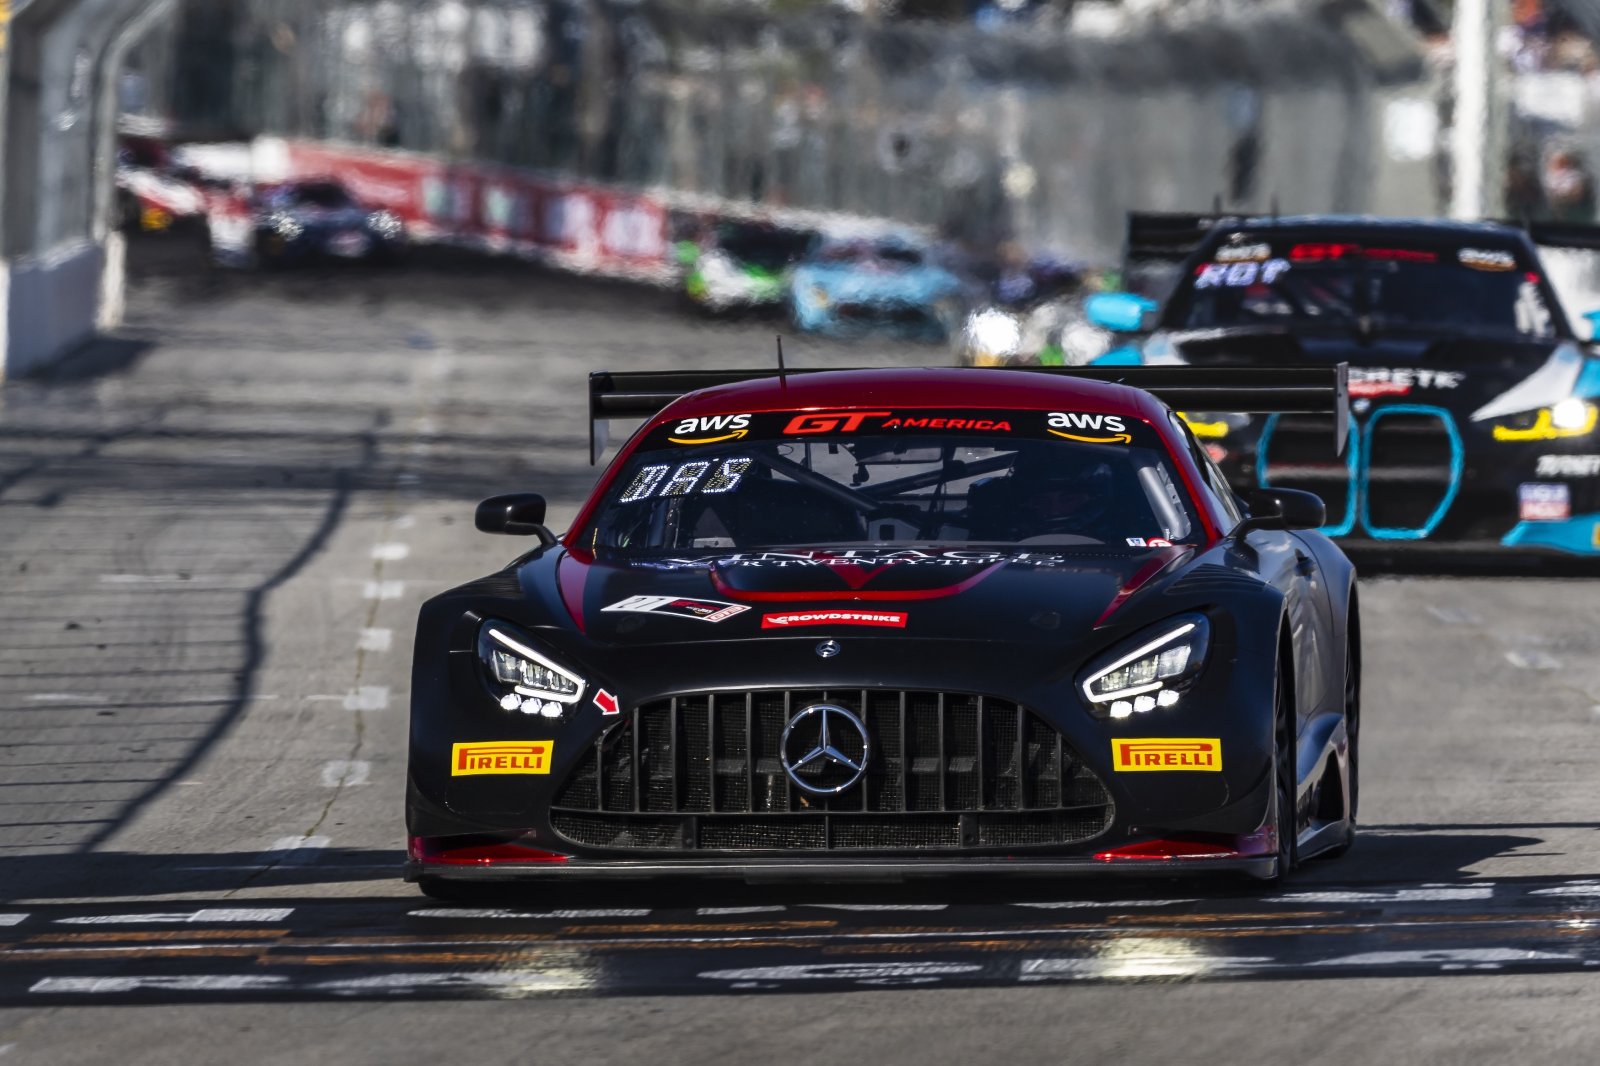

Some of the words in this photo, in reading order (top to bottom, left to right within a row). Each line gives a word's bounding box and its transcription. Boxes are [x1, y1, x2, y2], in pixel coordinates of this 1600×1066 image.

[674, 413, 752, 435] aws
[783, 411, 892, 435] GT
[881, 418, 1012, 431] AMERICA
[1047, 411, 1127, 432] aws
[767, 613, 901, 625] CROWDSTRIKE
[458, 746, 545, 771] PIRELLI
[1120, 743, 1213, 766] PIRELLI
